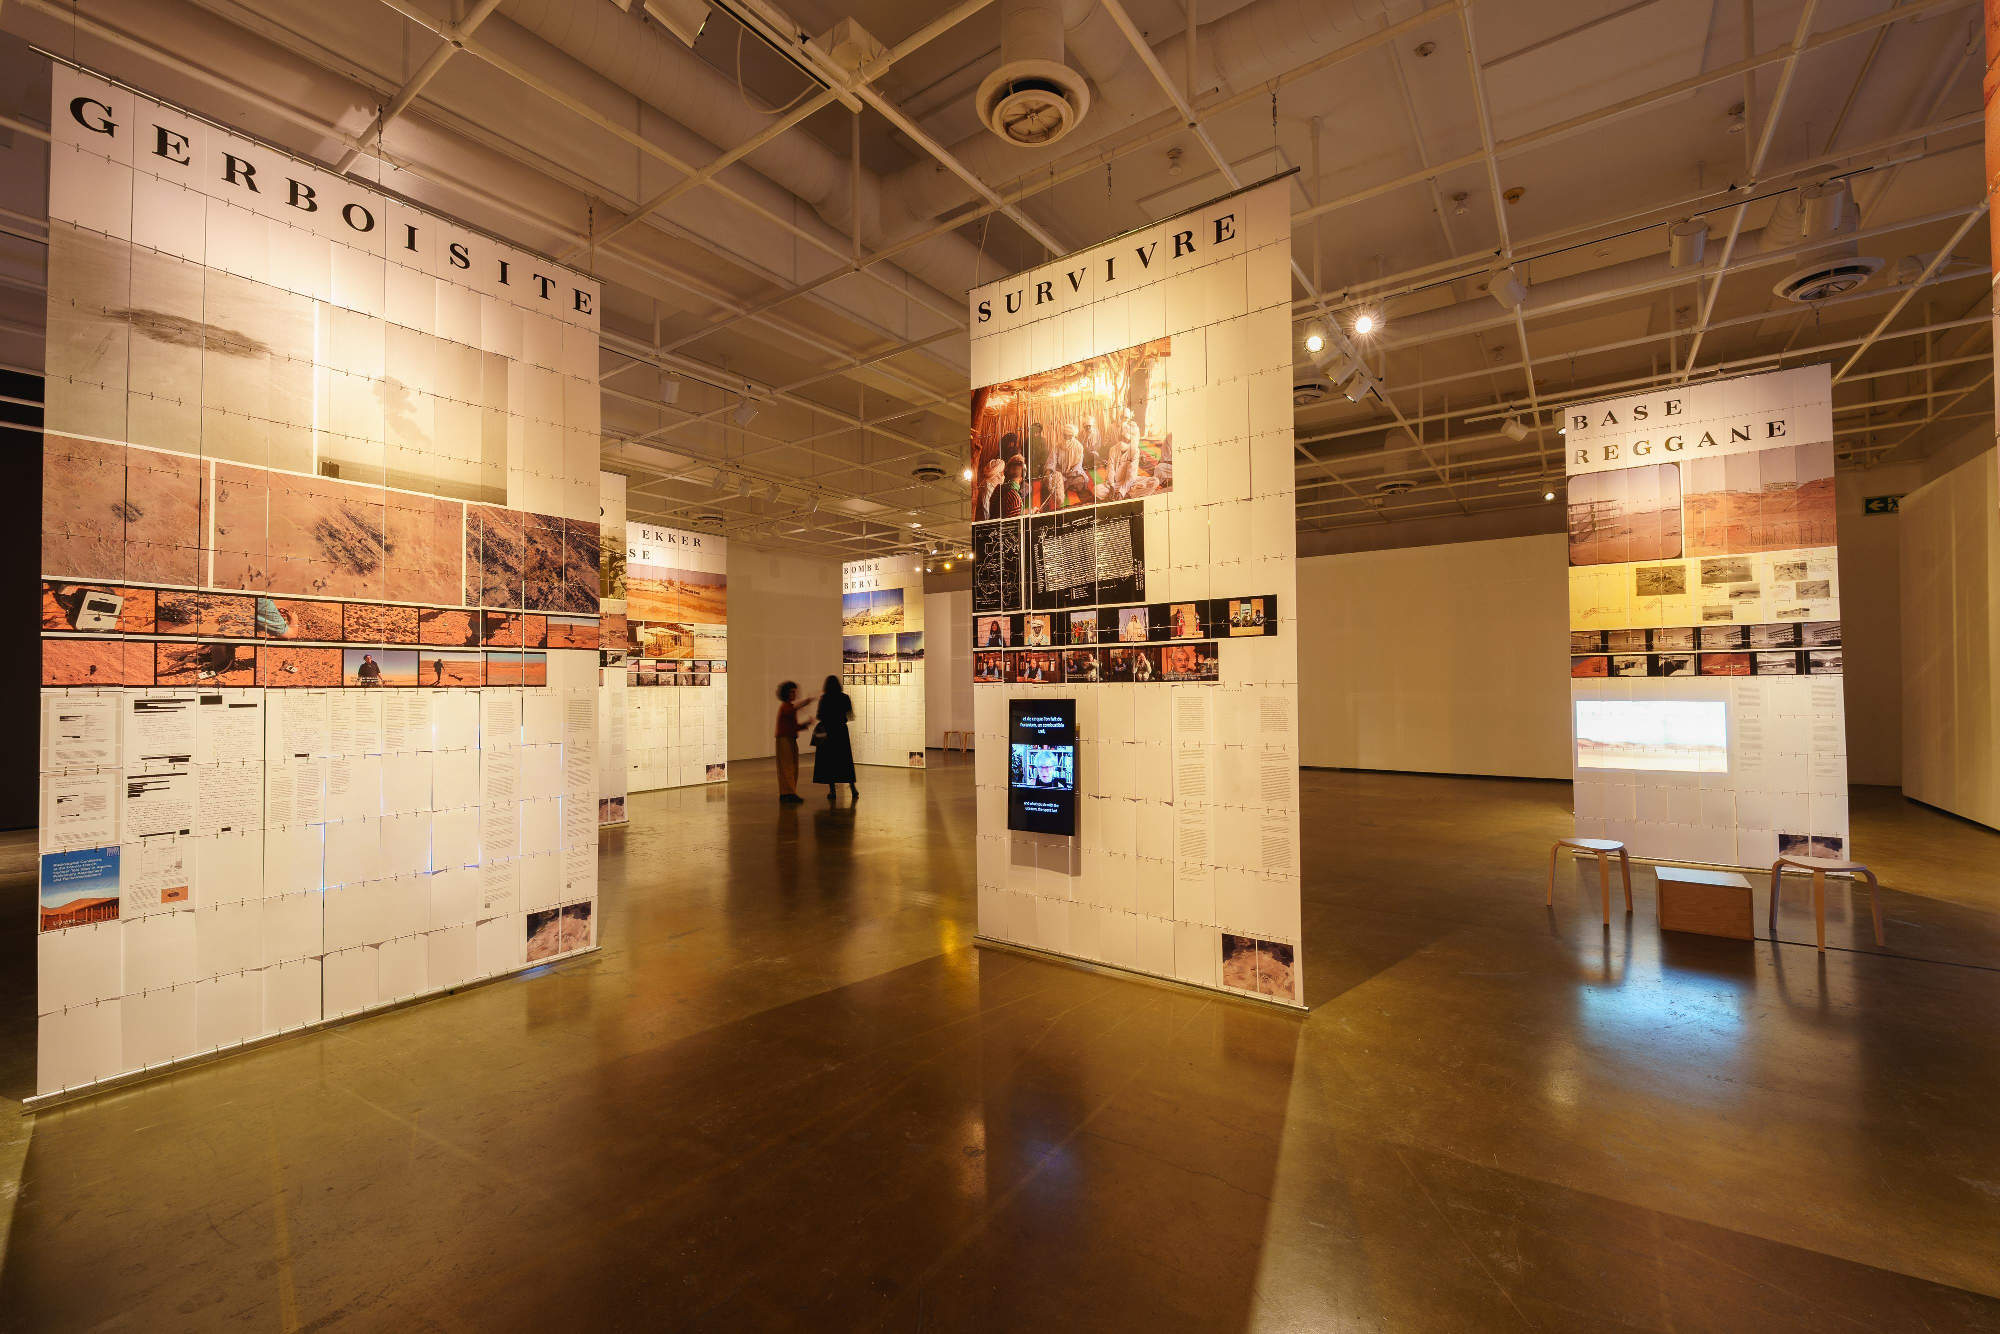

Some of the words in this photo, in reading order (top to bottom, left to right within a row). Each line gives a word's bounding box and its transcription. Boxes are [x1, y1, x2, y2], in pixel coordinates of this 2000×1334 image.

[70, 96, 593, 316] GERBOISITE
[977, 213, 1236, 324] SURVIVRE
[1572, 399, 1682, 431] BASE
[1574, 420, 1786, 465] REGGANE
[642, 529, 701, 547] EKKER
[843, 562, 880, 574] BOMBE
[843, 579, 880, 590] BERYL
